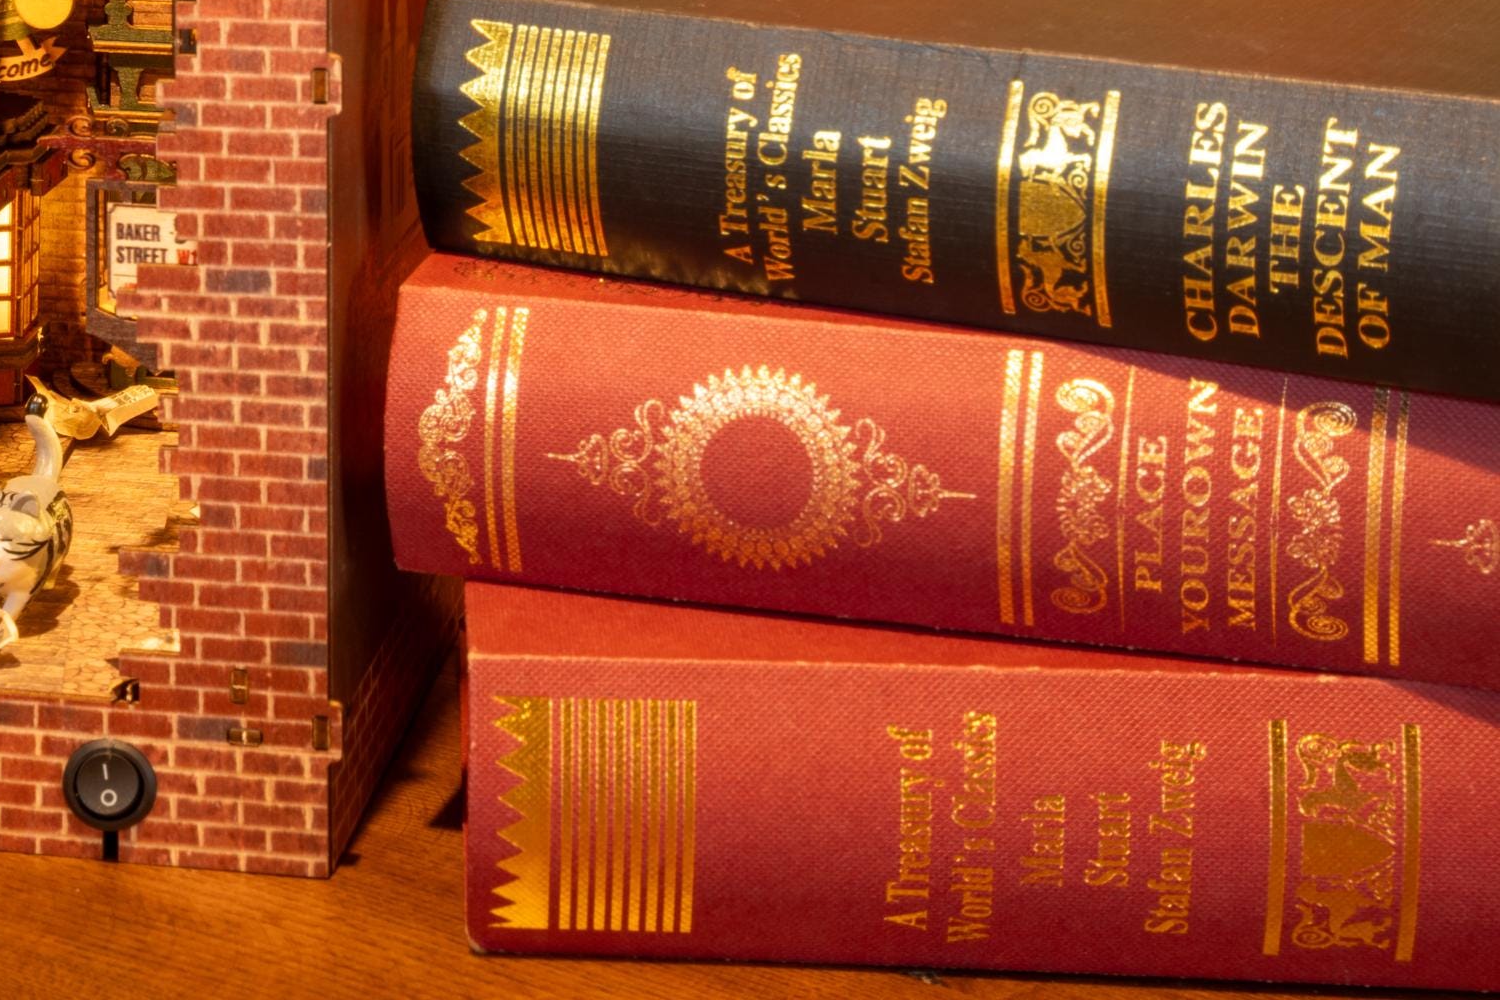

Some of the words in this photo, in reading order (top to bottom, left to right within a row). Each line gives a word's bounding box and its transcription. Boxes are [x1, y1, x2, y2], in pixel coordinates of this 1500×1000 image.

[726, 66, 757, 101] of
[757, 53, 801, 166] Classics
[719, 107, 758, 236] Treasury
[852, 135, 892, 243] Stuart
[898, 97, 947, 190] Zweig
[116, 222, 160, 242] BAKER
[116, 246, 168, 264] STREET
[724, 246, 754, 265] A
[898, 197, 934, 284] Stafan
[1183, 102, 1228, 341] CHARLES
[1226, 119, 1269, 338] DARWIN
[1269, 184, 1305, 294] THE
[1312, 116, 1358, 360] DESCENT
[1358, 142, 1401, 272] MAN
[1357, 282, 1391, 349] OF
[1134, 435, 1168, 594] PLACE
[1227, 407, 1263, 632] MESSAGE
[887, 724, 932, 760] of
[951, 710, 997, 829] Classics
[1149, 739, 1206, 838] Zweig
[886, 767, 945, 904] Treasury
[1084, 791, 1131, 888] Stuart
[883, 910, 928, 931] A
[1145, 848, 1191, 934] Stafan
